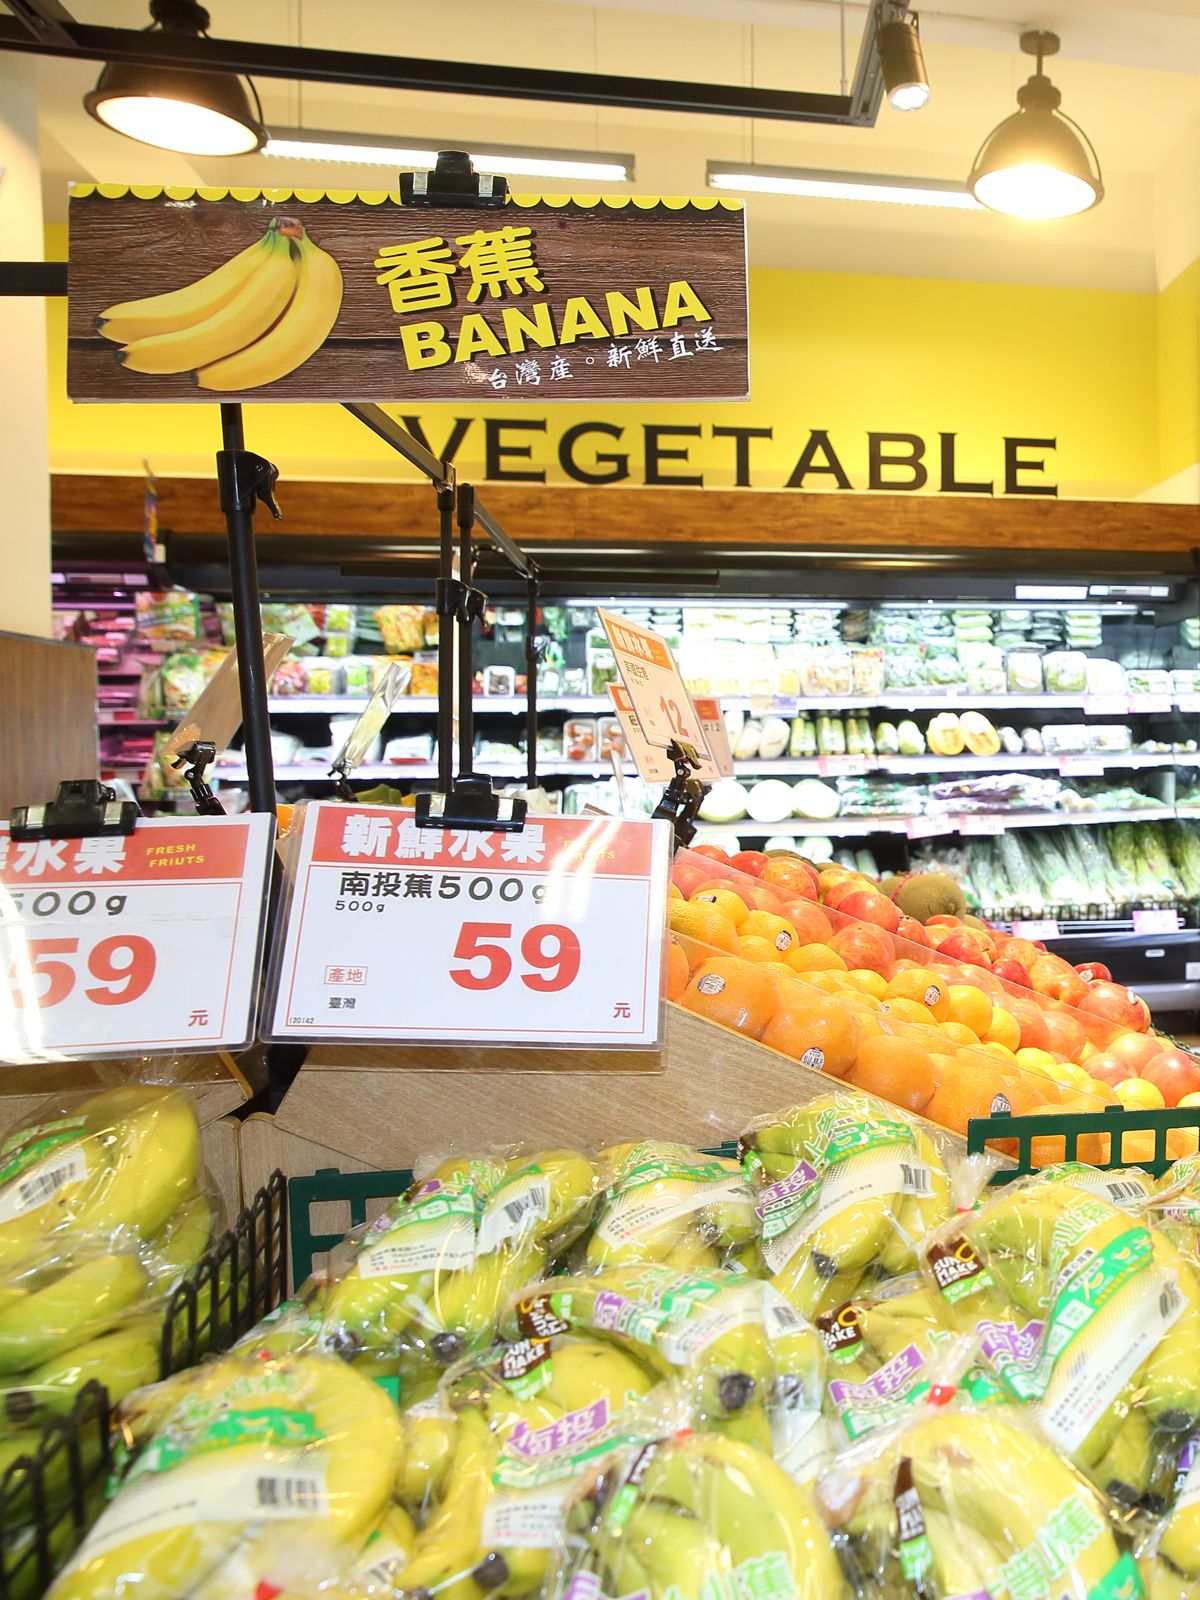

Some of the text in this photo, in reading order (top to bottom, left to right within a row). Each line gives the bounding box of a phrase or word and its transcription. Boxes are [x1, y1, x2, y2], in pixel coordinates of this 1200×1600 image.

[375, 226, 545, 313] 香蕉
[400, 280, 712, 371] BANANA
[402, 415, 1058, 496] VEGETABLE
[660, 696, 689, 738] 12
[0, 836, 126, 877] 水果
[146, 844, 196, 855] FRESH
[341, 814, 546, 864] 新鮮水果
[150, 855, 205, 868] FRIUTS
[335, 900, 385, 913] 500g
[8, 934, 157, 1009] 59
[328, 968, 362, 983] 產地
[449, 922, 581, 993] 59
[188, 1010, 208, 1027] 元
[613, 1002, 631, 1019] 元
[937, 1262, 978, 1284] MAKE
